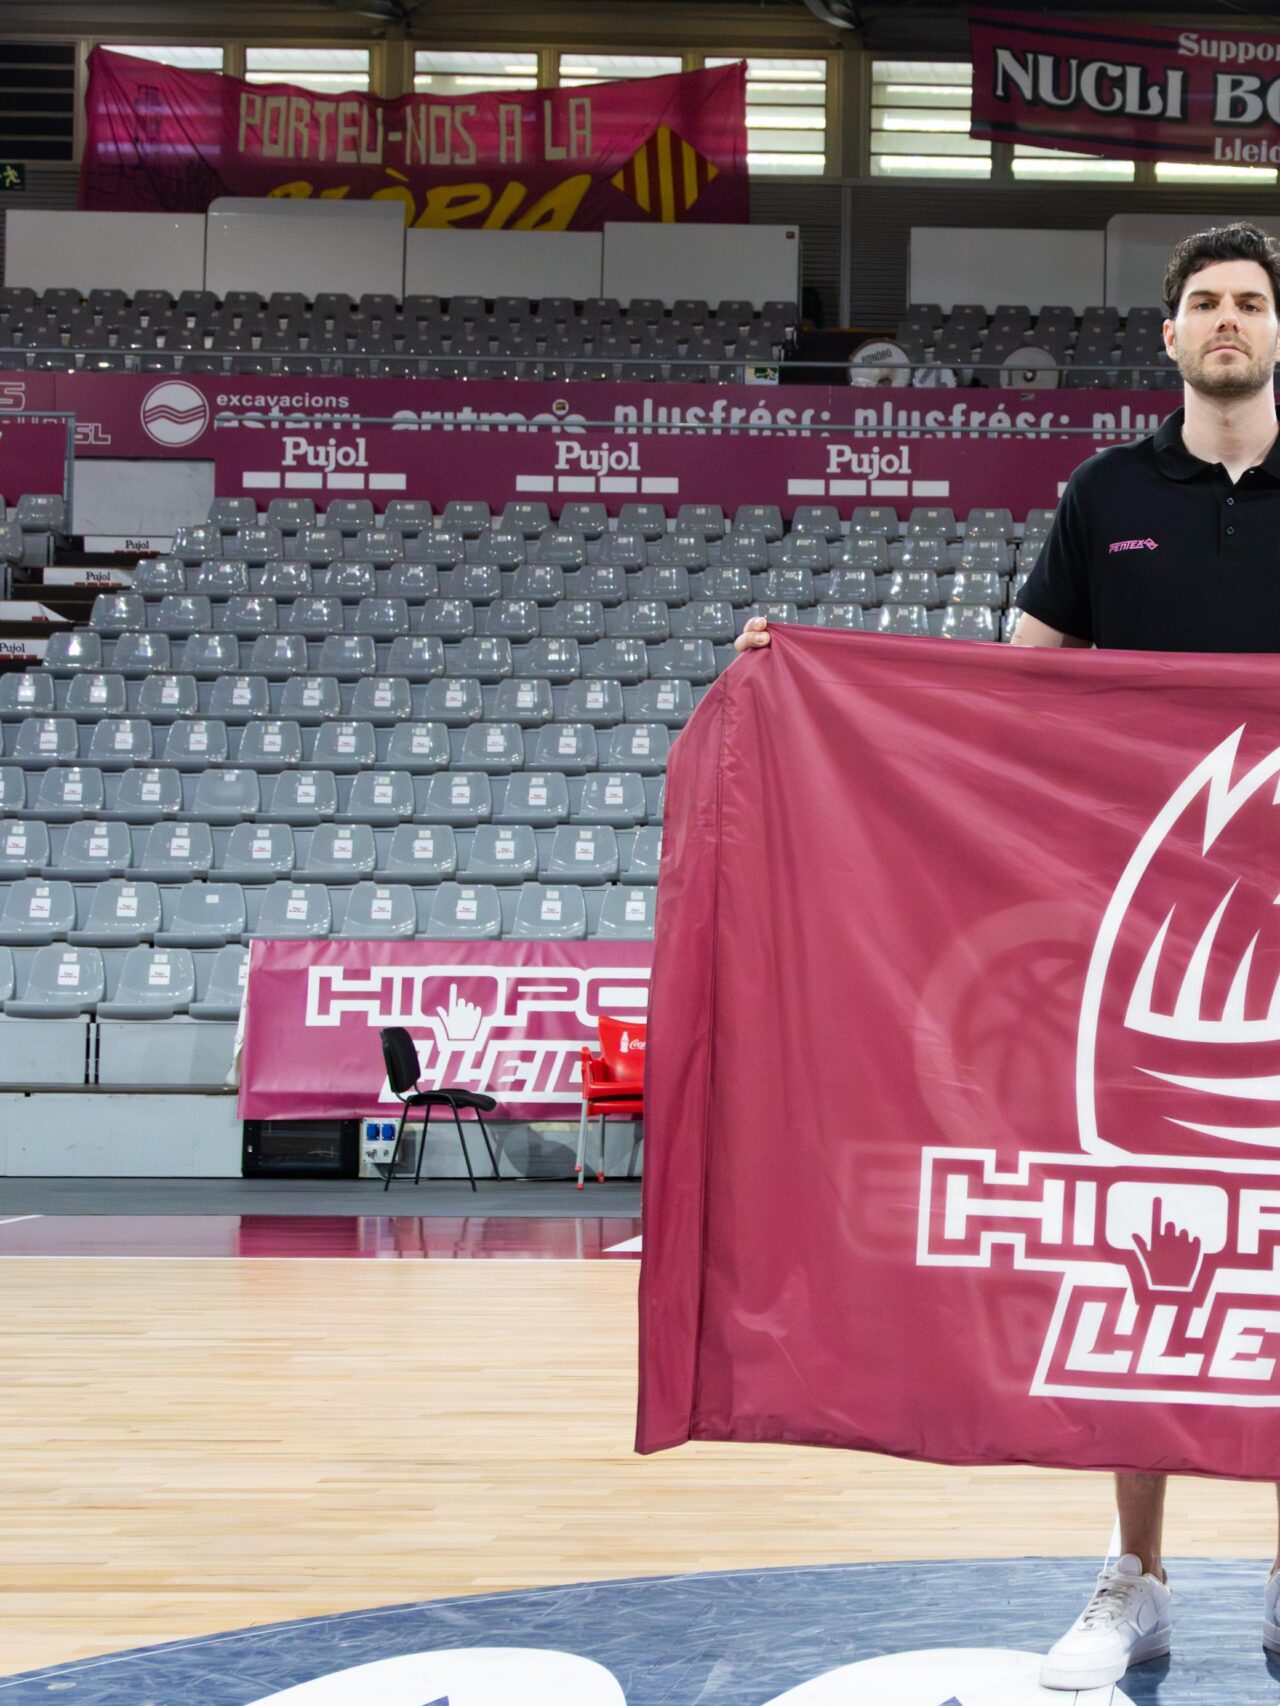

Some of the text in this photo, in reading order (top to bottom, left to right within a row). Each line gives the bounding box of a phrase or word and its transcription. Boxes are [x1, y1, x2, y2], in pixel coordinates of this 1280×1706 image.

[994, 47, 1185, 120] NUCLI
[238, 92, 592, 166] PORTEU-NOS A LA
[267, 167, 592, 231] ÒRIA
[216, 392, 350, 408] excavacions
[281, 436, 369, 473] Pujol
[555, 440, 641, 476] Pujol
[826, 444, 912, 480] Pujol
[125, 540, 150, 551] Pujol
[86, 571, 111, 583] Pujol
[0, 642, 26, 653] Pujol
[316, 975, 650, 1019] HIOPO
